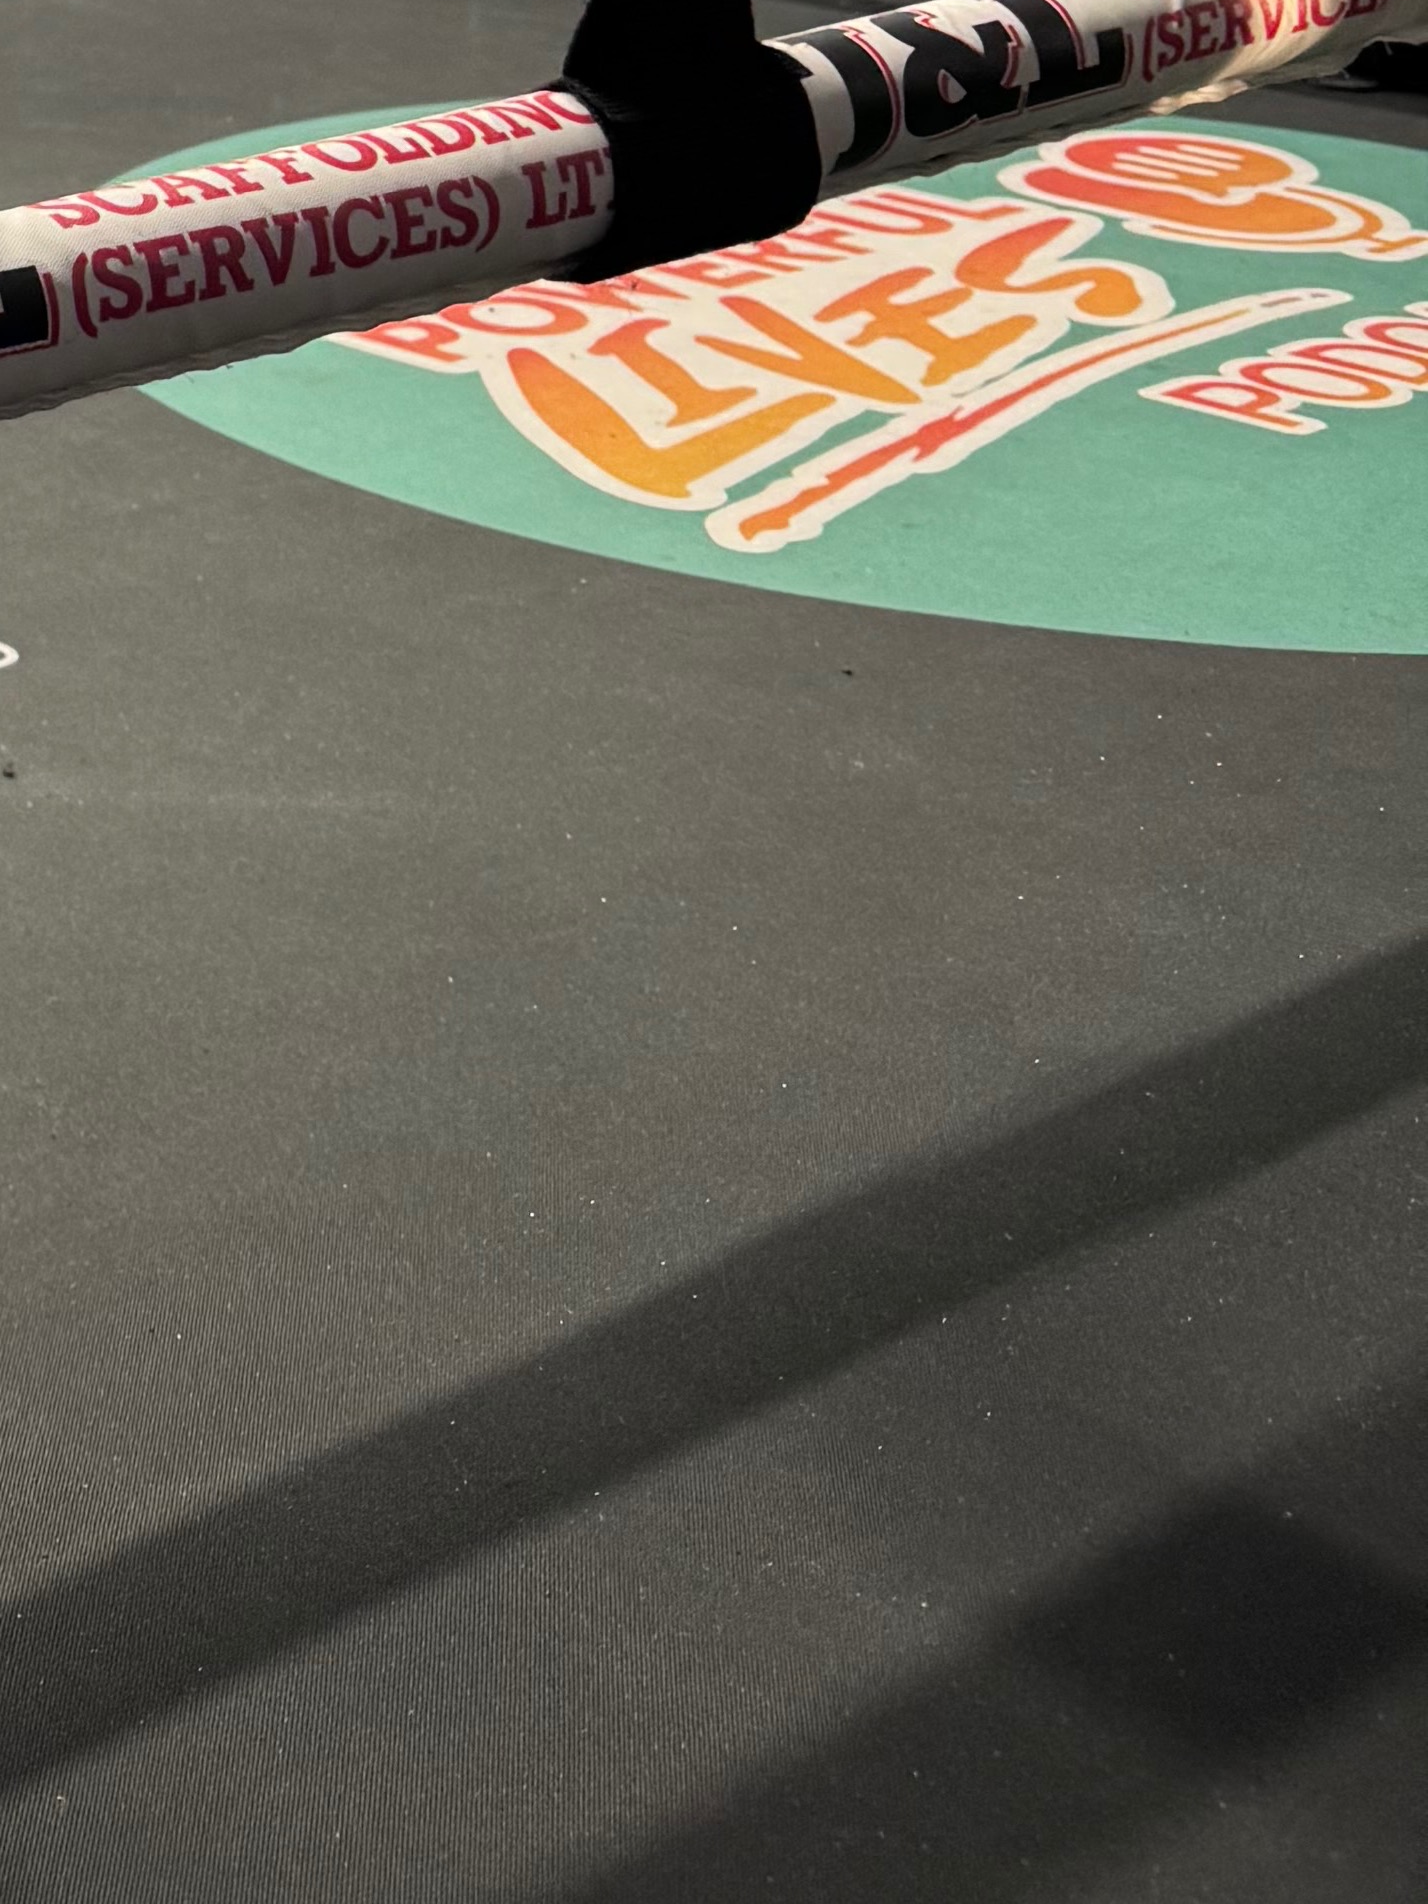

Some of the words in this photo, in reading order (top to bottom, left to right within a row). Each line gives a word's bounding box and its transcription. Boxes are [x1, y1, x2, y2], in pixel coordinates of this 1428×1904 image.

[73, 172, 503, 338] (SERVICES)
[522, 142, 614, 232] LT
[504, 216, 1144, 500] LIVES
